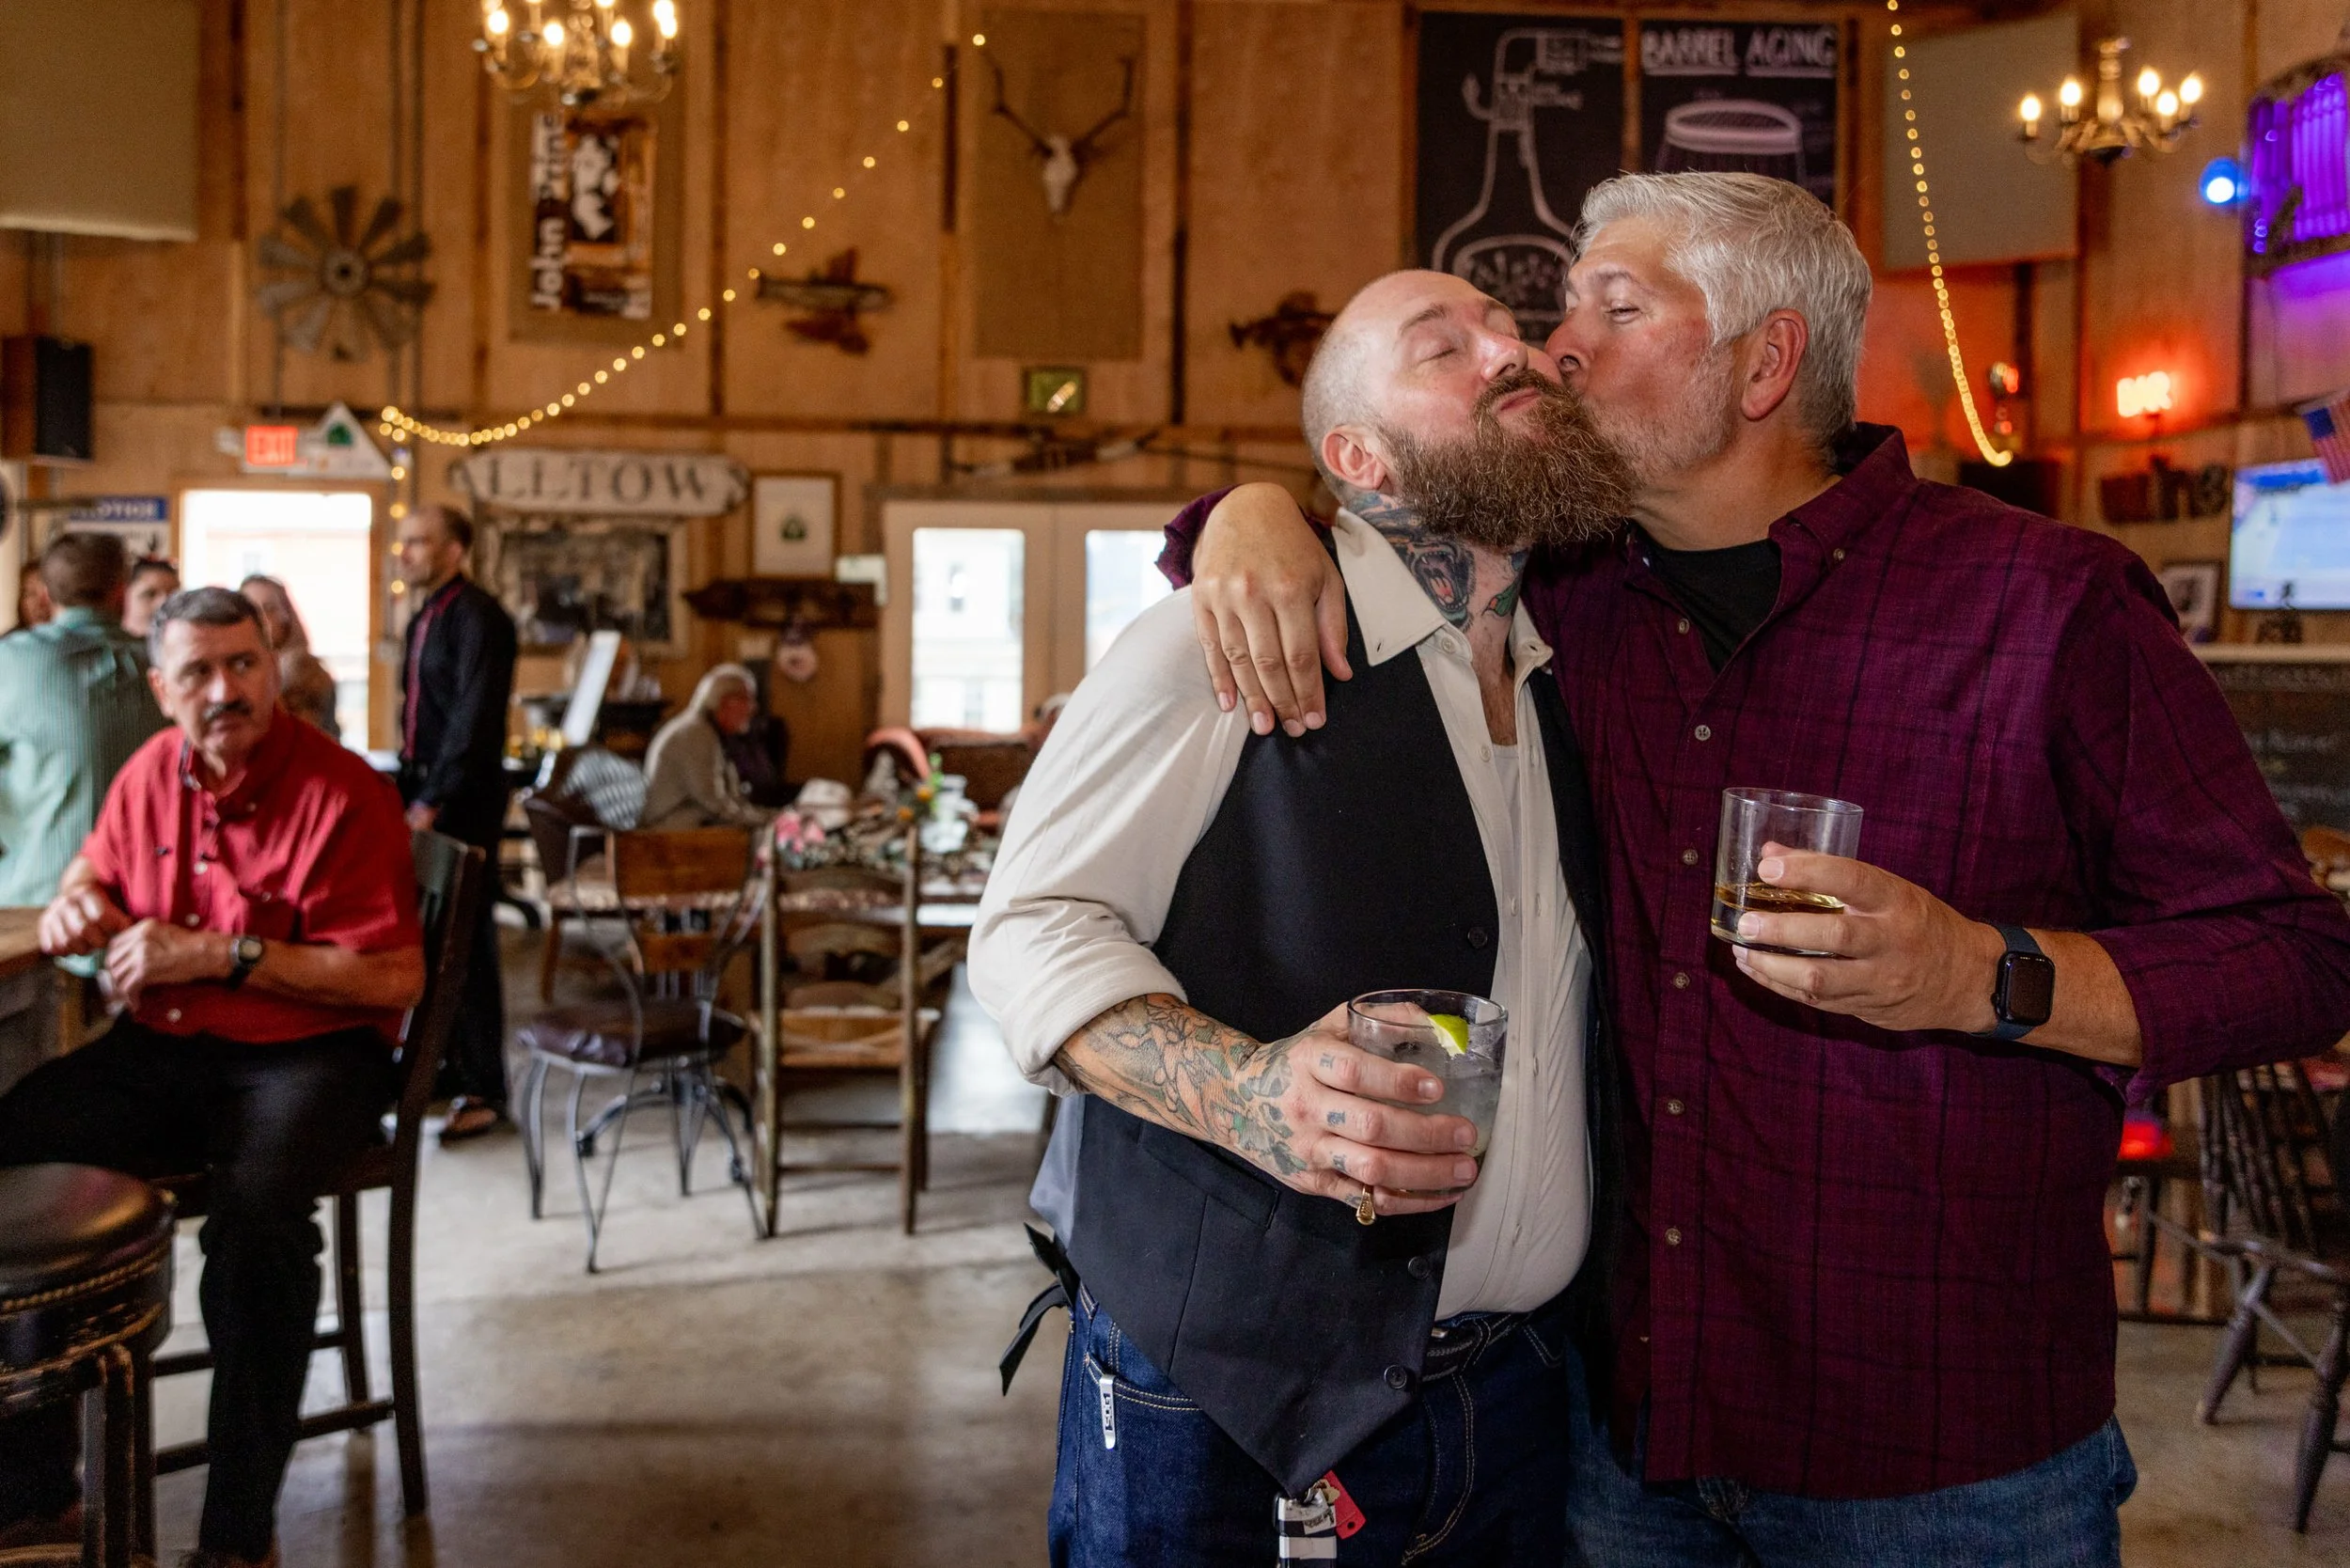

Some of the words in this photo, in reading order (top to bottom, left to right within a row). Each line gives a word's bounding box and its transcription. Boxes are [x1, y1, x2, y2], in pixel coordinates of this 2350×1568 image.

[1641, 29, 1738, 67] BARREL
[1746, 27, 1836, 67] AGING
[529, 217, 565, 309] John
[248, 430, 295, 462] EXIT
